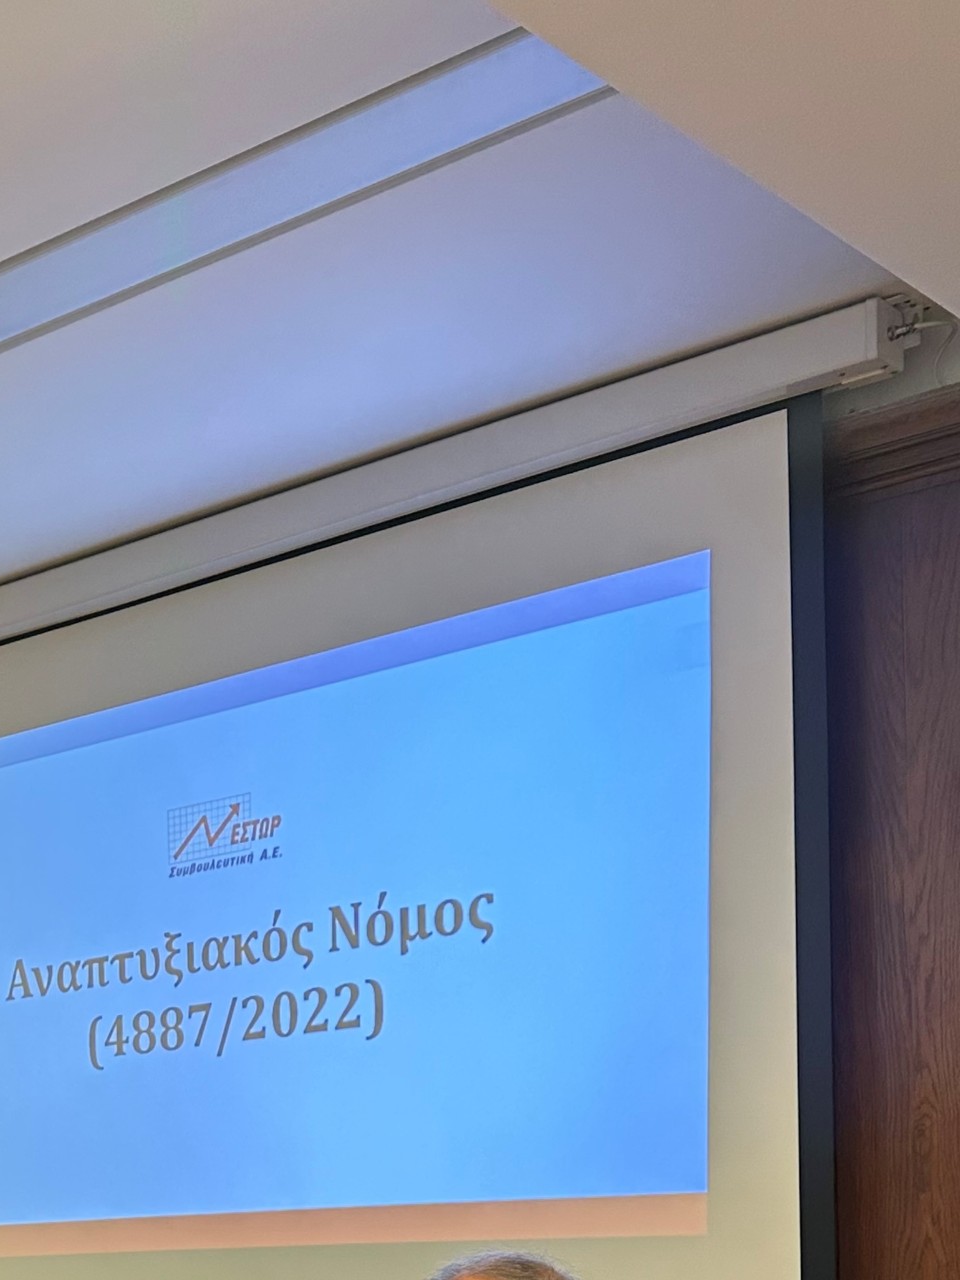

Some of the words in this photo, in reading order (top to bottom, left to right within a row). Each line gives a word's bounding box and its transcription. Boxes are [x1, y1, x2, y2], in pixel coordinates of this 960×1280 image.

[168, 851, 254, 878] Συμβουλευτική
[260, 846, 283, 862] Α.Ε.
[6, 910, 314, 1001] Αναπτυξιακός
[329, 892, 494, 955] Νόμος
[88, 979, 384, 1070] (4887/2022)
